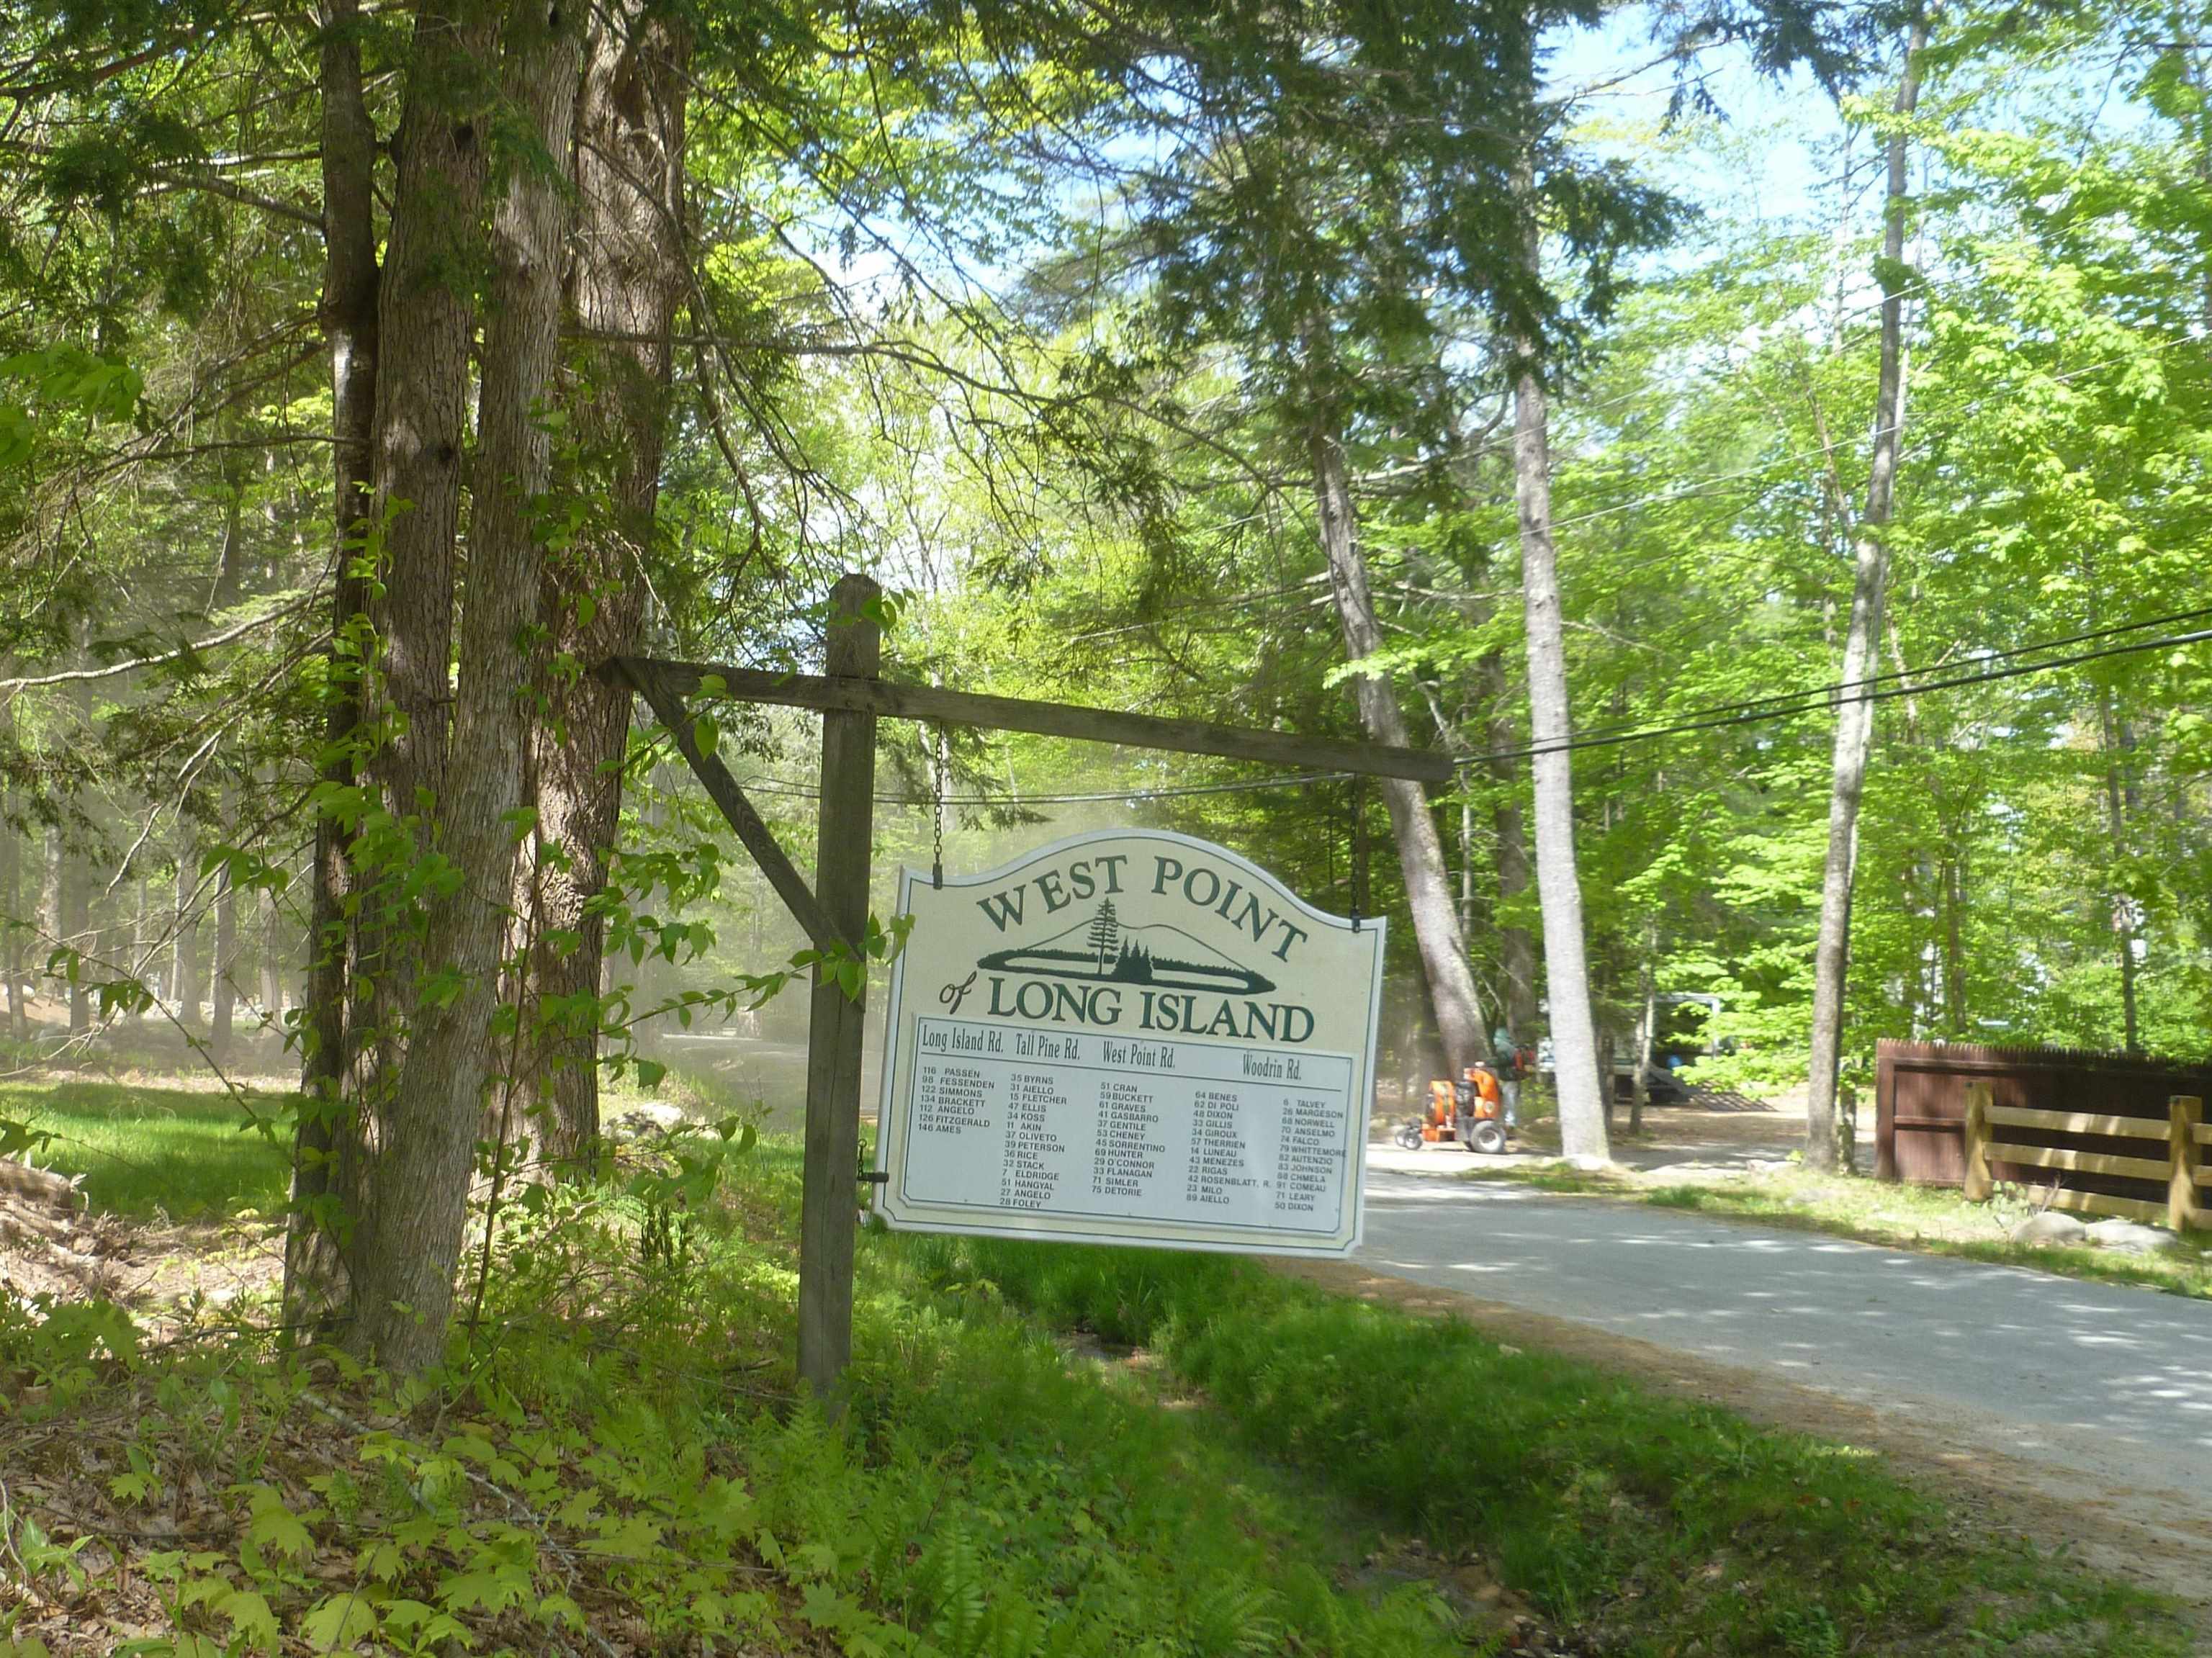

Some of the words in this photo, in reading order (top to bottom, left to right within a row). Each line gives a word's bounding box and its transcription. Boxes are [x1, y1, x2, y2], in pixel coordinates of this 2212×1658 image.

[976, 855, 1128, 932] WEST
[1152, 855, 1308, 963] POINT
[939, 970, 978, 1014] of
[988, 977, 1122, 1025] LONG
[1139, 990, 1314, 1043] ISLAND
[922, 1024, 948, 1053] Long
[952, 1027, 984, 1051] Island
[988, 1030, 1003, 1053] Rd.
[1016, 1032, 1035, 1055] Tall
[1038, 1035, 1059, 1058] Pine
[1064, 1037, 1080, 1060] Rd.
[1102, 1041, 1125, 1063] West
[1130, 1044, 1156, 1067] Point
[1160, 1047, 1175, 1068] Rd.
[1243, 1054, 1282, 1078] Woodrin
[1287, 1058, 1301, 1081] Rd.
[945, 1068, 980, 1078] PASSEN
[940, 1077, 995, 1089] FESSENDEN
[1024, 1075, 1054, 1084] BYRNS
[922, 1085, 936, 1094] 122
[939, 1086, 983, 1098] SIMMONS
[1022, 1085, 1054, 1094] AIELLO
[1100, 1081, 1110, 1090] 51
[1113, 1083, 1138, 1092] CRAN
[921, 1094, 935, 1103] 134
[938, 1096, 986, 1107] BRACKETT
[1010, 1092, 1019, 1101] 15
[1022, 1094, 1067, 1104] FLETCHER
[1209, 1092, 1238, 1101] BENES
[920, 1104, 932, 1112] 112
[938, 1105, 974, 1115] ANGELO
[1022, 1103, 1046, 1112] ELLIS
[1111, 1102, 1146, 1112] GRAVES
[1220, 1102, 1239, 1111] POLI
[1020, 1112, 1045, 1122] KOSS
[1207, 1110, 1233, 1119] DIXON
[936, 1115, 990, 1127] FITZGERALD
[1110, 1120, 1146, 1131] GENTILE
[1205, 1119, 1233, 1129] GILLIS
[919, 1123, 933, 1132] 146
[935, 1125, 961, 1135] AMES
[1020, 1122, 1042, 1131] AKIN
[1019, 1132, 1057, 1142] OLIVETO
[1110, 1130, 1146, 1140] CHENEY
[1292, 1136, 1319, 1145] FALCO
[1018, 1141, 1065, 1153] PETERSON
[1109, 1140, 1165, 1153] SORRENTINO
[1017, 1150, 1038, 1160] RICE
[1108, 1149, 1143, 1158] HUNTER
[1017, 1160, 1044, 1170] STACK
[1015, 1170, 1060, 1181] ELDRIDGE
[1107, 1167, 1152, 1178] FLANAGAN
[1093, 1176, 1101, 1184] 71
[1106, 1177, 1138, 1186] SIMLER
[1014, 1189, 1051, 1199] ANGELO
[1105, 1186, 1142, 1197] DETORIE
[1201, 1185, 1223, 1194] MILO
[1013, 1199, 1041, 1208] FOLEY
